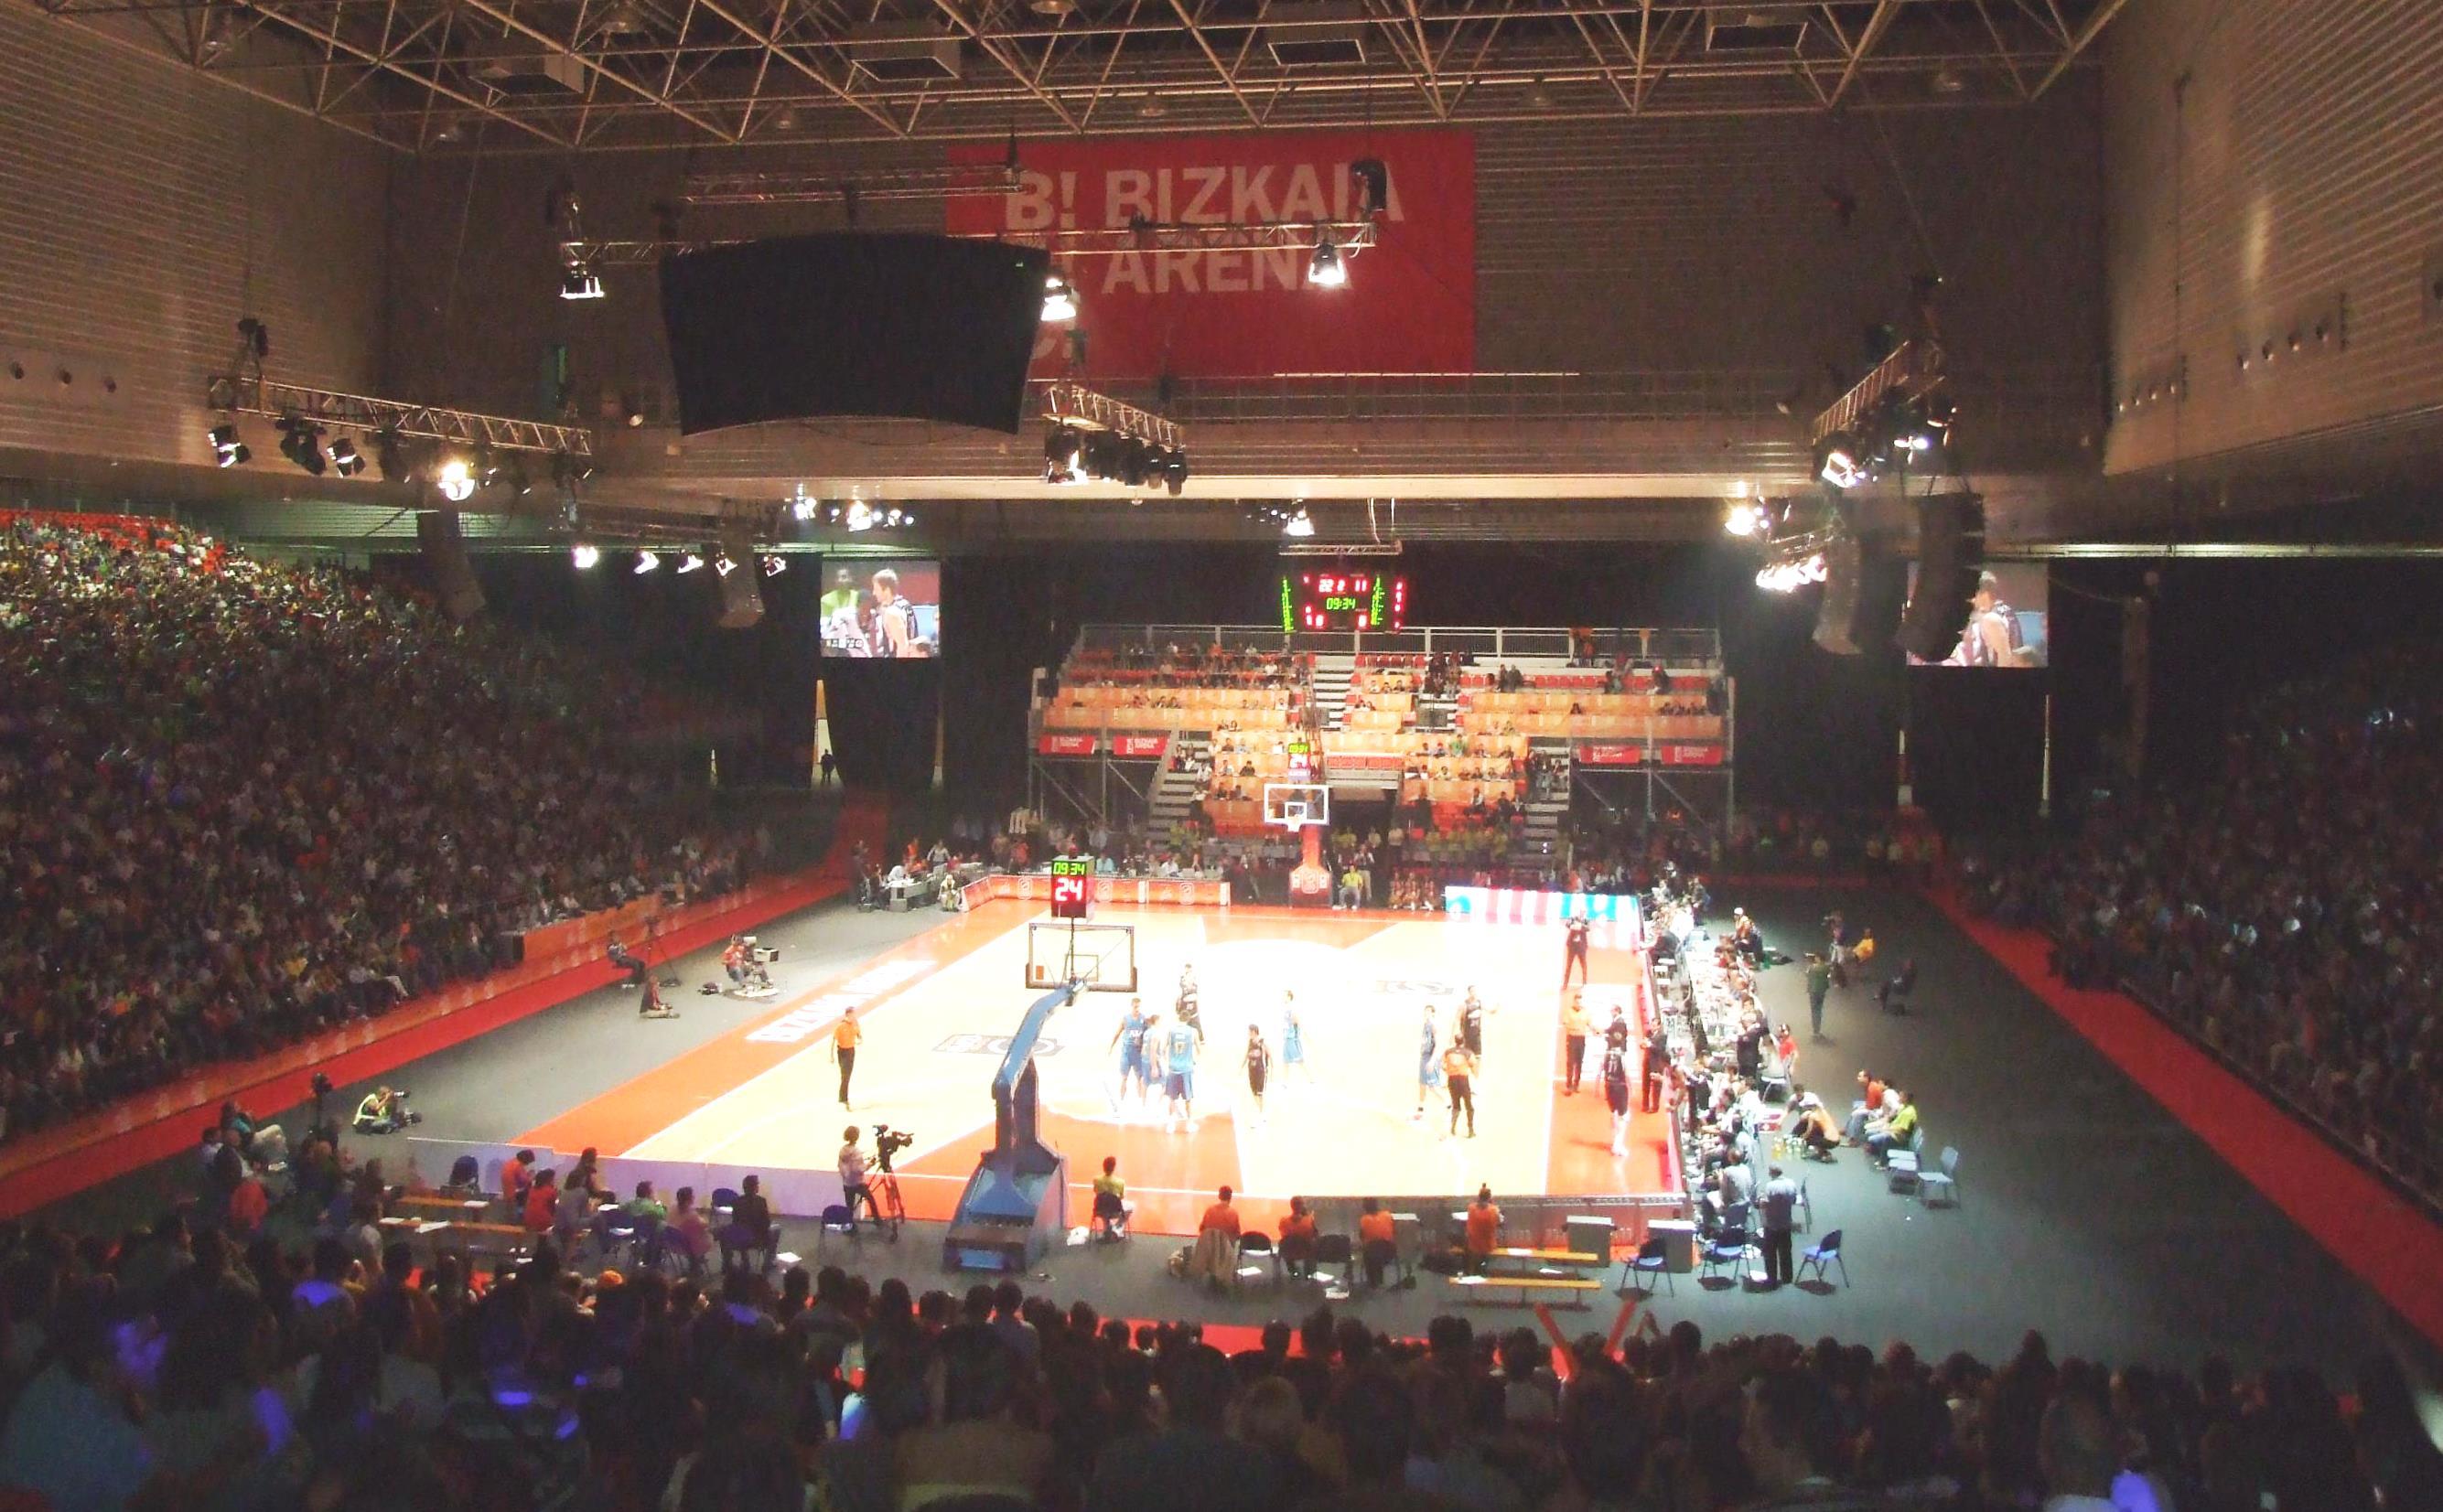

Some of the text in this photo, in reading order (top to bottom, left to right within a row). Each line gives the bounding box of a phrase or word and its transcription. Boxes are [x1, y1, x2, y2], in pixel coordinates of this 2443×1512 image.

[1006, 162, 1404, 229] B! BIZKAIA
[1326, 597, 1356, 610] 09:34
[1053, 862, 1086, 875] 09:34
[1055, 877, 1083, 901] 24
